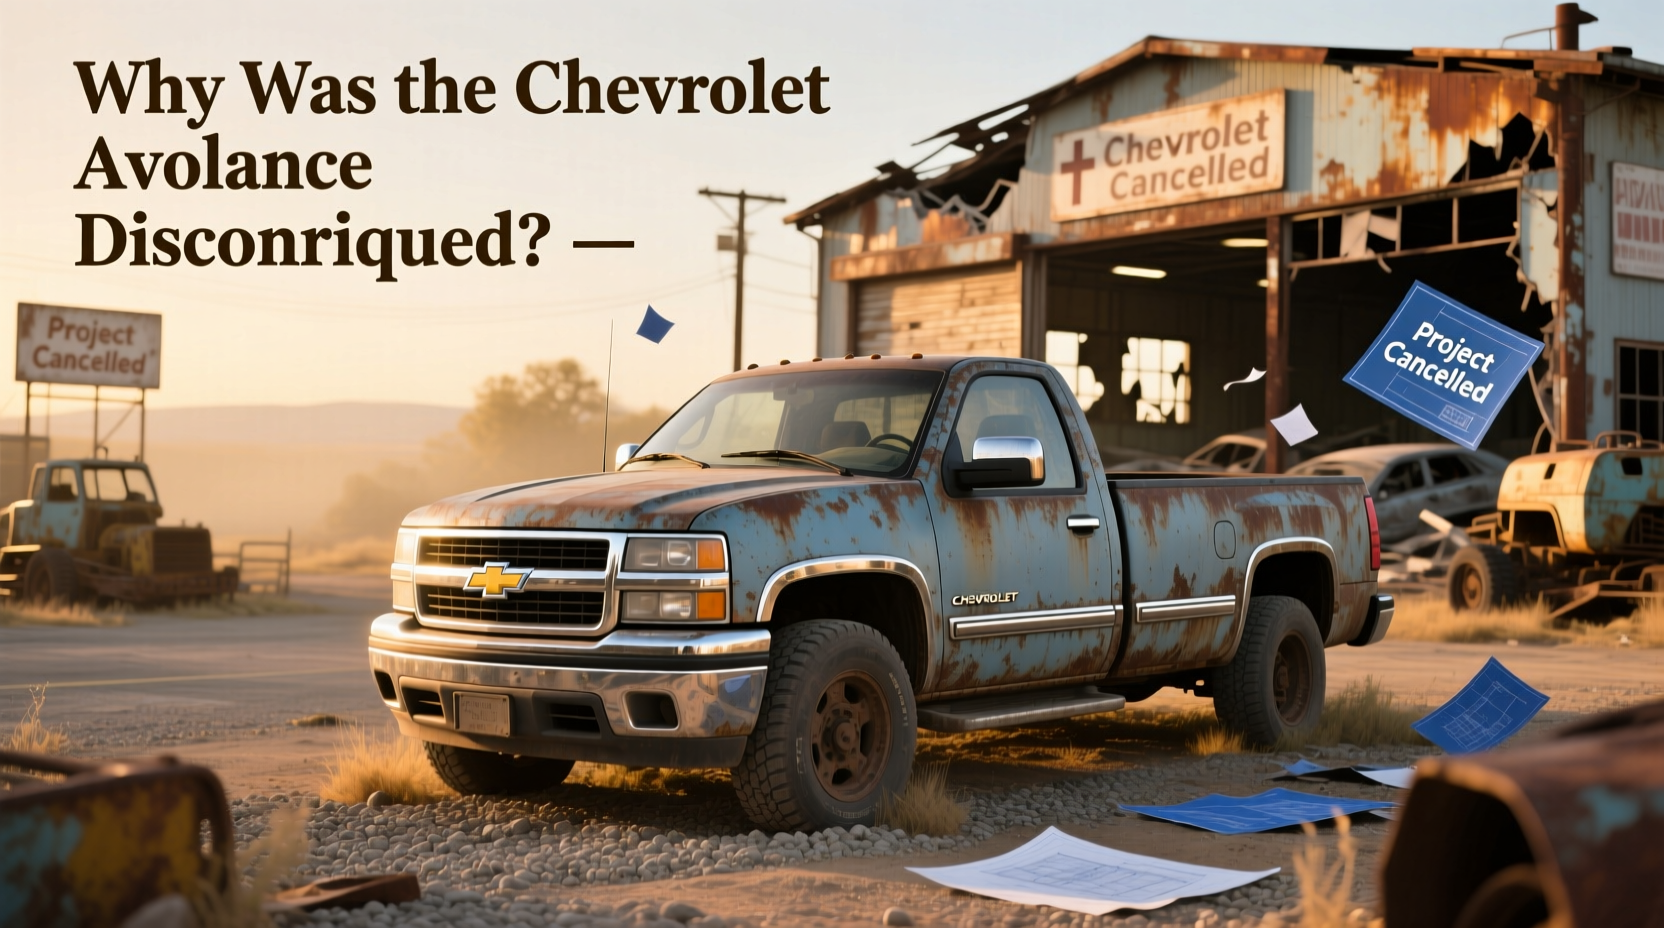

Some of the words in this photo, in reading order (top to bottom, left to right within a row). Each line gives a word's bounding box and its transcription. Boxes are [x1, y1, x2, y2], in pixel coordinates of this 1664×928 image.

[1104, 109, 1269, 167] Chevrolet
[1110, 146, 1269, 200] Cancelled
[48, 316, 135, 349] Project
[1412, 321, 1495, 373] Project
[32, 345, 146, 375] Cancelled
[1384, 341, 1494, 404] Cancelled
